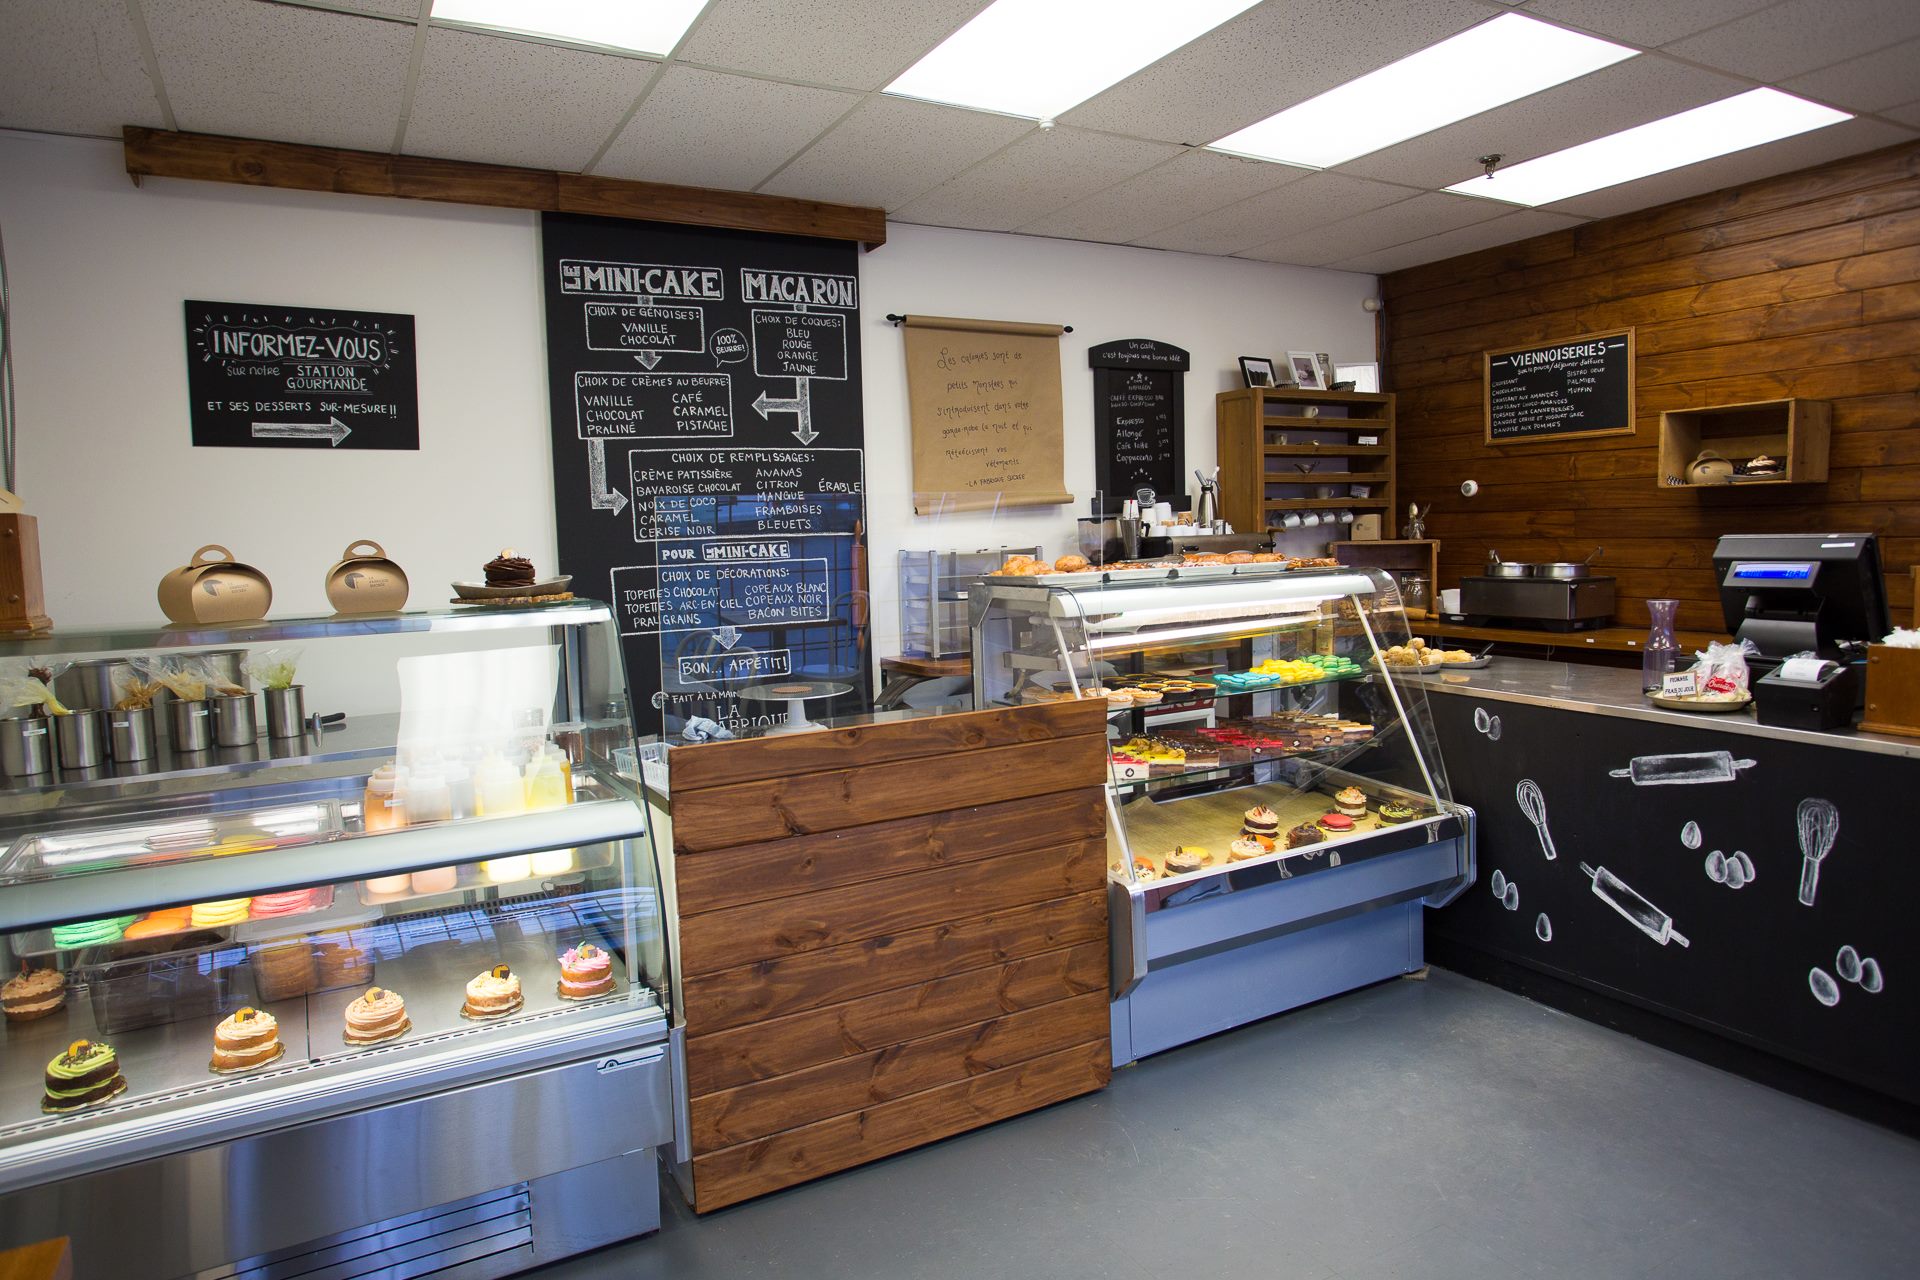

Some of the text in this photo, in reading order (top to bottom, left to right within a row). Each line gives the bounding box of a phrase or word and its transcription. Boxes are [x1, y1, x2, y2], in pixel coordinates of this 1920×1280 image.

[563, 266, 720, 297] LE MINI-CAKE
[744, 273, 854, 306] MACARON
[588, 306, 616, 316] CHOIX
[622, 308, 636, 317] DE
[756, 315, 841, 327] CHOIX DE COQUES:
[622, 323, 668, 334] VANILLE
[787, 329, 810, 338] BLEU
[213, 330, 381, 361] INFORMEZ-VOUS
[620, 335, 677, 346] CHOCOLAT
[717, 334, 737, 345] 100%
[782, 340, 812, 349] ROUGE
[716, 345, 745, 354] BEURRE!
[1511, 342, 1606, 367] VIENNOISERIES
[777, 351, 819, 361] ORANGE
[992, 351, 1009, 364] sont
[1014, 351, 1023, 360] de
[227, 364, 354, 377] sur notre STATION
[783, 362, 816, 374] JAUNE
[287, 377, 368, 391] GOURMANDE
[577, 375, 608, 388] CHOIX
[612, 377, 627, 386] DE
[632, 375, 673, 387] CRÈMES
[691, 377, 729, 386] BEURRE:
[1567, 378, 1596, 386] PALMIER
[1568, 386, 1592, 394] MUFFIN
[584, 395, 634, 406] VANILLE
[672, 391, 703, 404] CAFÉ
[207, 401, 222, 411] ET
[229, 401, 249, 412] SES
[255, 401, 311, 412] DESSERTS
[673, 406, 728, 417] CARAMEL
[995, 402, 1011, 414] dans
[586, 409, 645, 422] CHOCOLAT
[587, 422, 636, 435] PRALINÉ
[677, 420, 728, 432] PISTACHE
[1012, 422, 1019, 431] et
[671, 452, 815, 463] CHOIX DE REMPLISSAGES:
[633, 469, 674, 482] CRÈME
[755, 468, 802, 478] ANANAS
[636, 483, 742, 497] BAVAROISE CHOCOLAT
[756, 480, 799, 490] CITRON
[818, 478, 861, 494] ÉRABLE
[757, 491, 805, 502] MANGUE
[639, 497, 716, 512] NOIX DE COCO
[755, 505, 822, 517] FRAMBOISES
[640, 513, 700, 525] CARAMEL
[758, 519, 812, 530] BLEUETS
[639, 525, 716, 539] CERISE NOIR
[662, 549, 697, 560] POUR
[713, 543, 789, 559] MINI-CAKE
[661, 571, 691, 582] CHOIX
[696, 570, 710, 580] DE
[624, 586, 720, 601] TOPETTES CHOCOLAT
[744, 582, 826, 596] COPEAUX BLANC
[625, 599, 743, 614] TOPETTES ARC-EN-CIEL
[745, 594, 822, 607] COPEAUX NOIR
[663, 613, 702, 625] GRAINS
[748, 606, 822, 620] BACON BITES
[682, 656, 788, 675] BON... APPÉTIT!
[672, 694, 694, 704] FAIT
[706, 692, 717, 700] LA
[716, 705, 741, 720] LA
